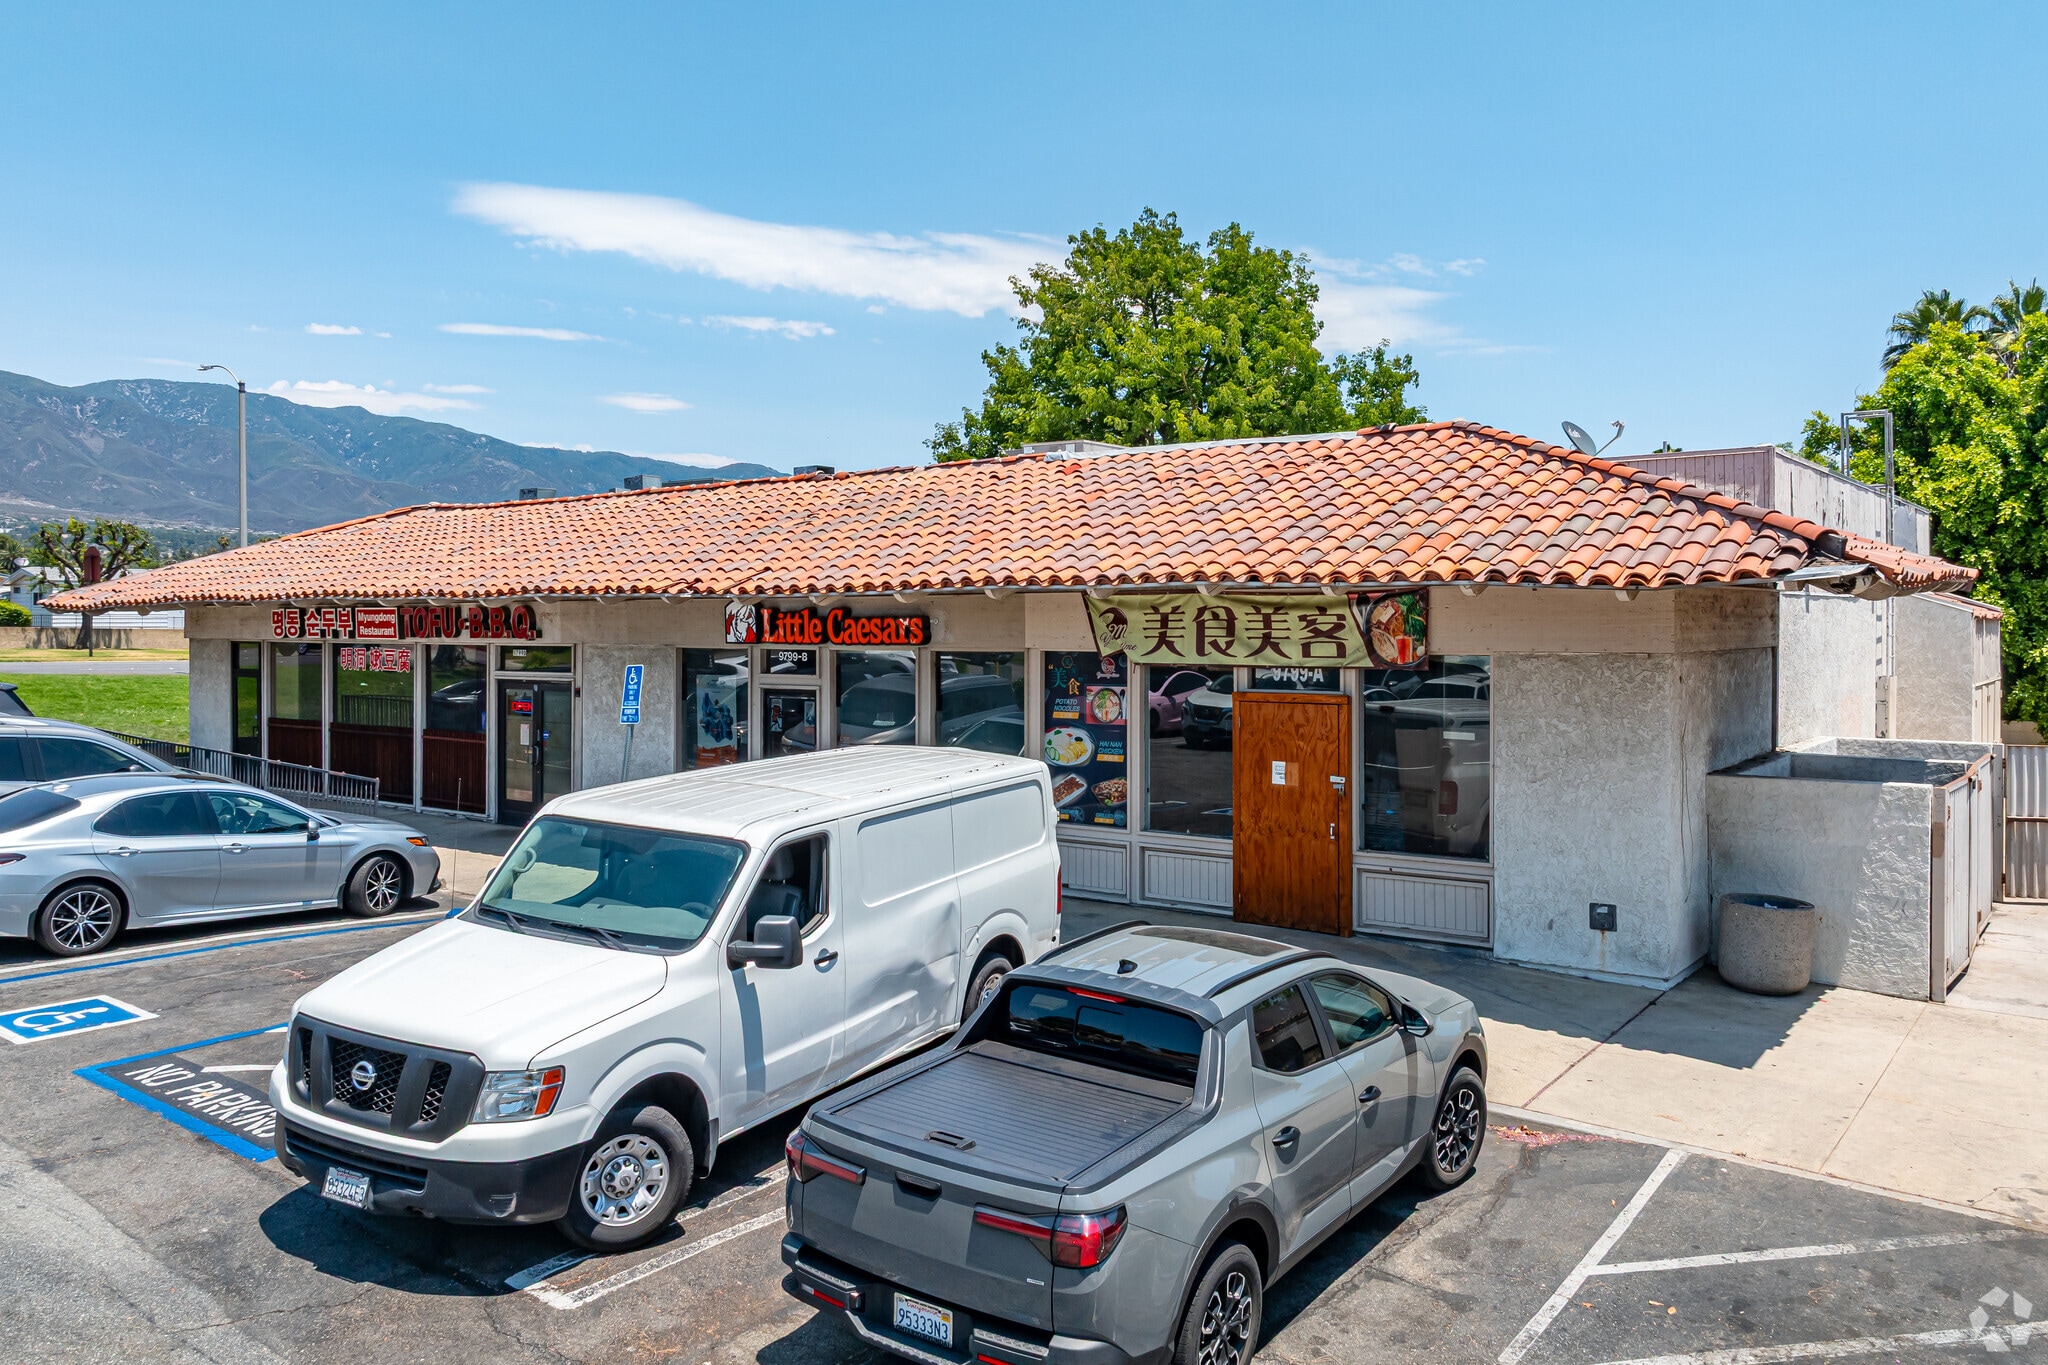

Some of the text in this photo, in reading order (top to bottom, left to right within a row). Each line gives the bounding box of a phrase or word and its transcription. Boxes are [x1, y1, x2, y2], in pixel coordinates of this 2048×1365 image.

[271, 608, 353, 638] 명동 순두부
[357, 612, 395, 623] Myungdong
[400, 606, 456, 639] TOFU
[760, 606, 923, 646] Little Caesars
[359, 626, 395, 636] Restaurant
[1140, 604, 1350, 660] 美食美客
[340, 647, 367, 671] 明洞
[777, 651, 808, 662] 9799-B
[1098, 747, 1123, 755] CHICKEN
[124, 1063, 196, 1087] NO
[898, 1307, 949, 1341] 95333N3
